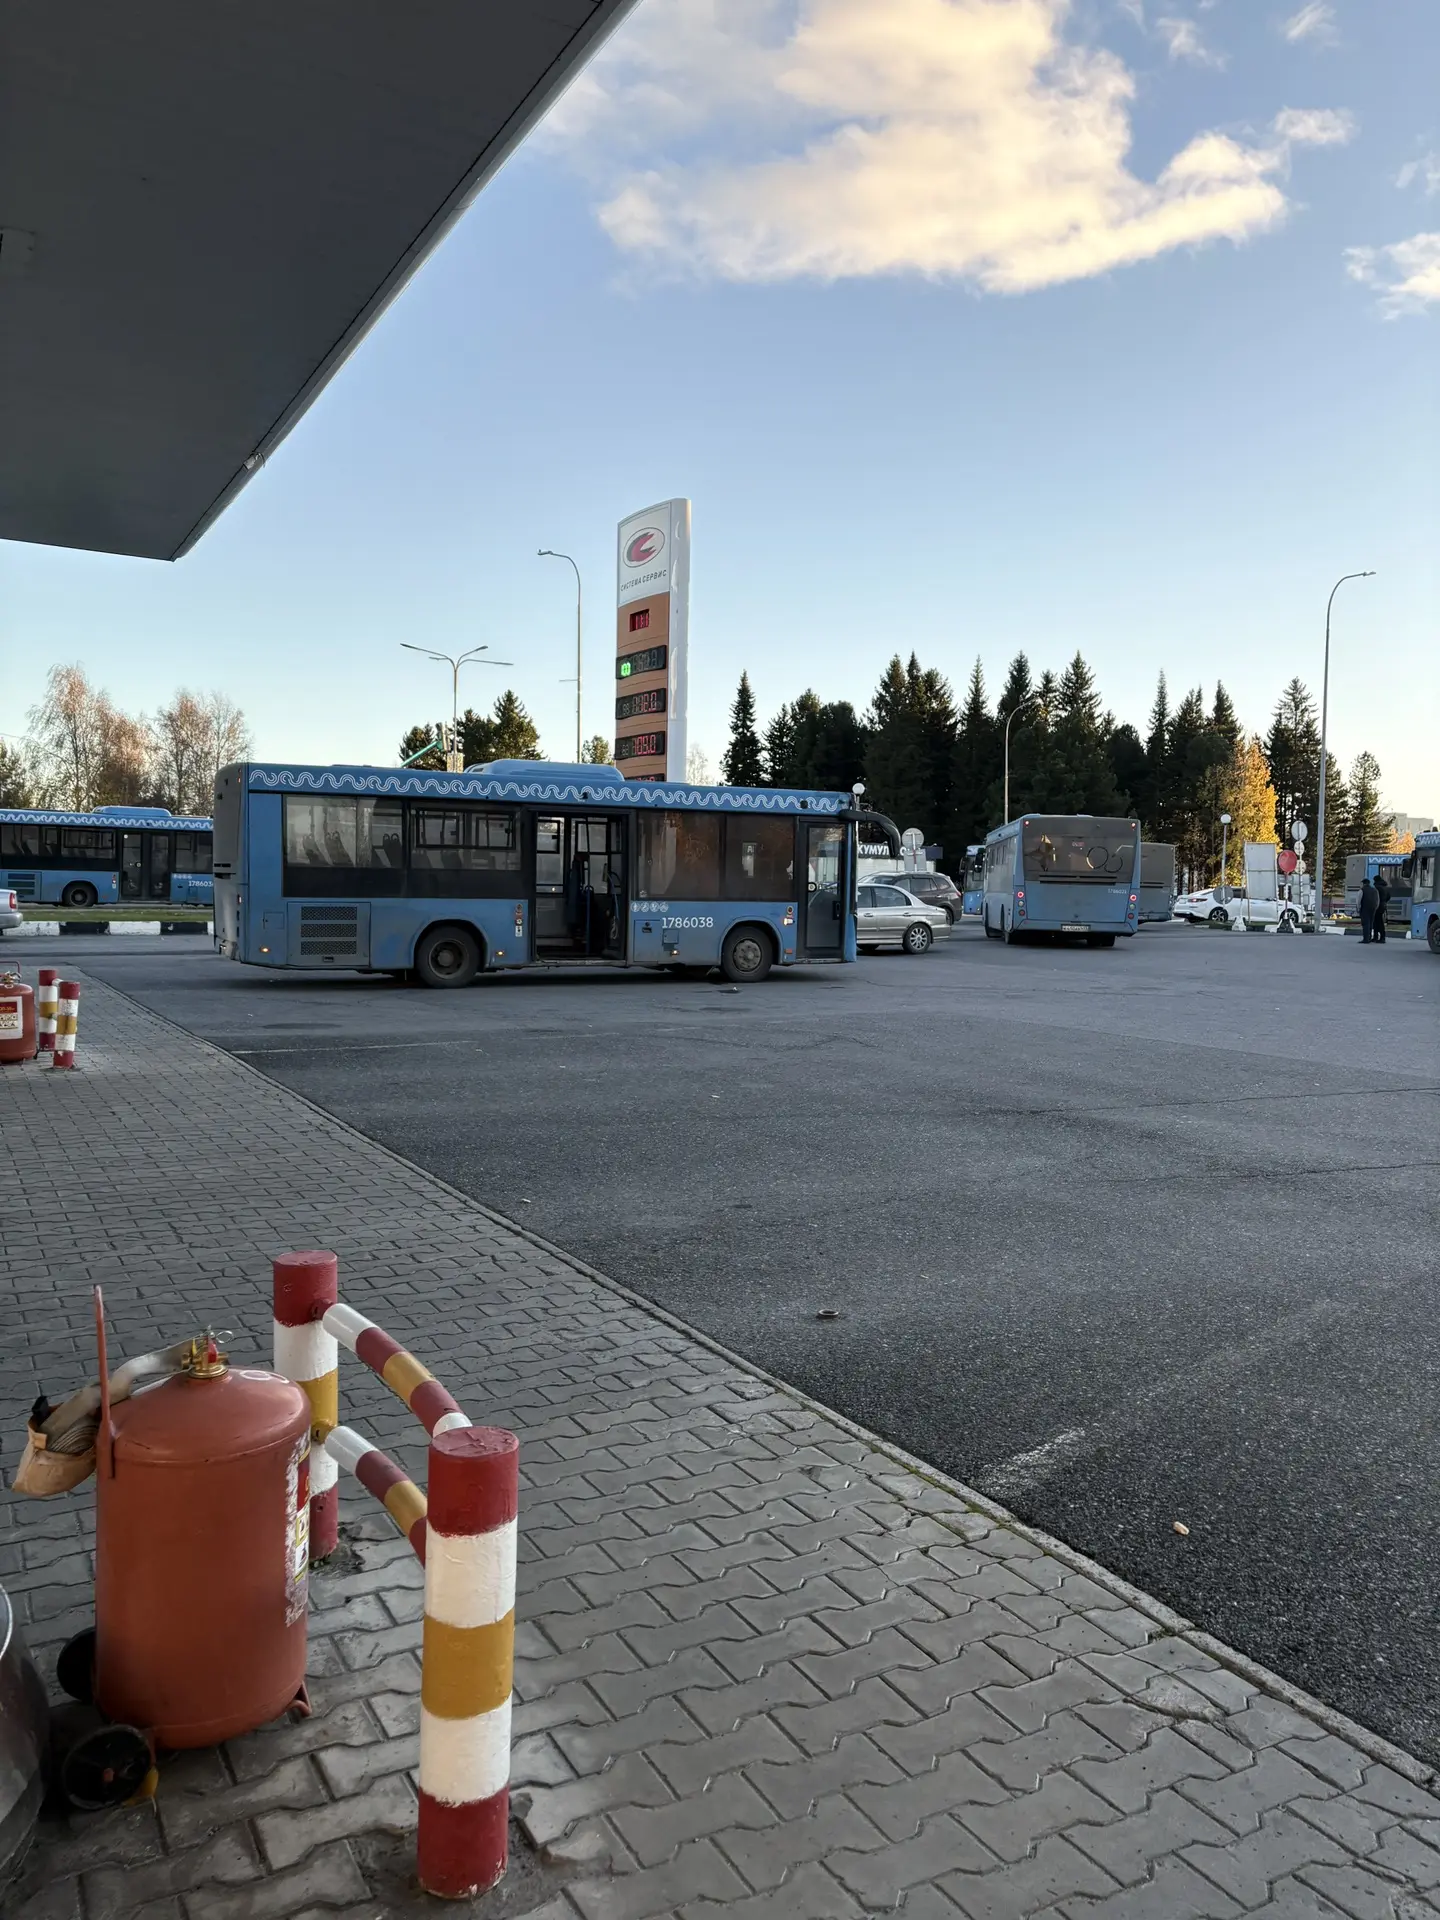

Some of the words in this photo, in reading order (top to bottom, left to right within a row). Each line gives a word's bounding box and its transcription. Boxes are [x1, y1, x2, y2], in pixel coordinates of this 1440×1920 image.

[620, 577, 642, 592] СИСТЕМА
[642, 569, 668, 584] СЕРВИС
[661, 916, 714, 929] 1786038
